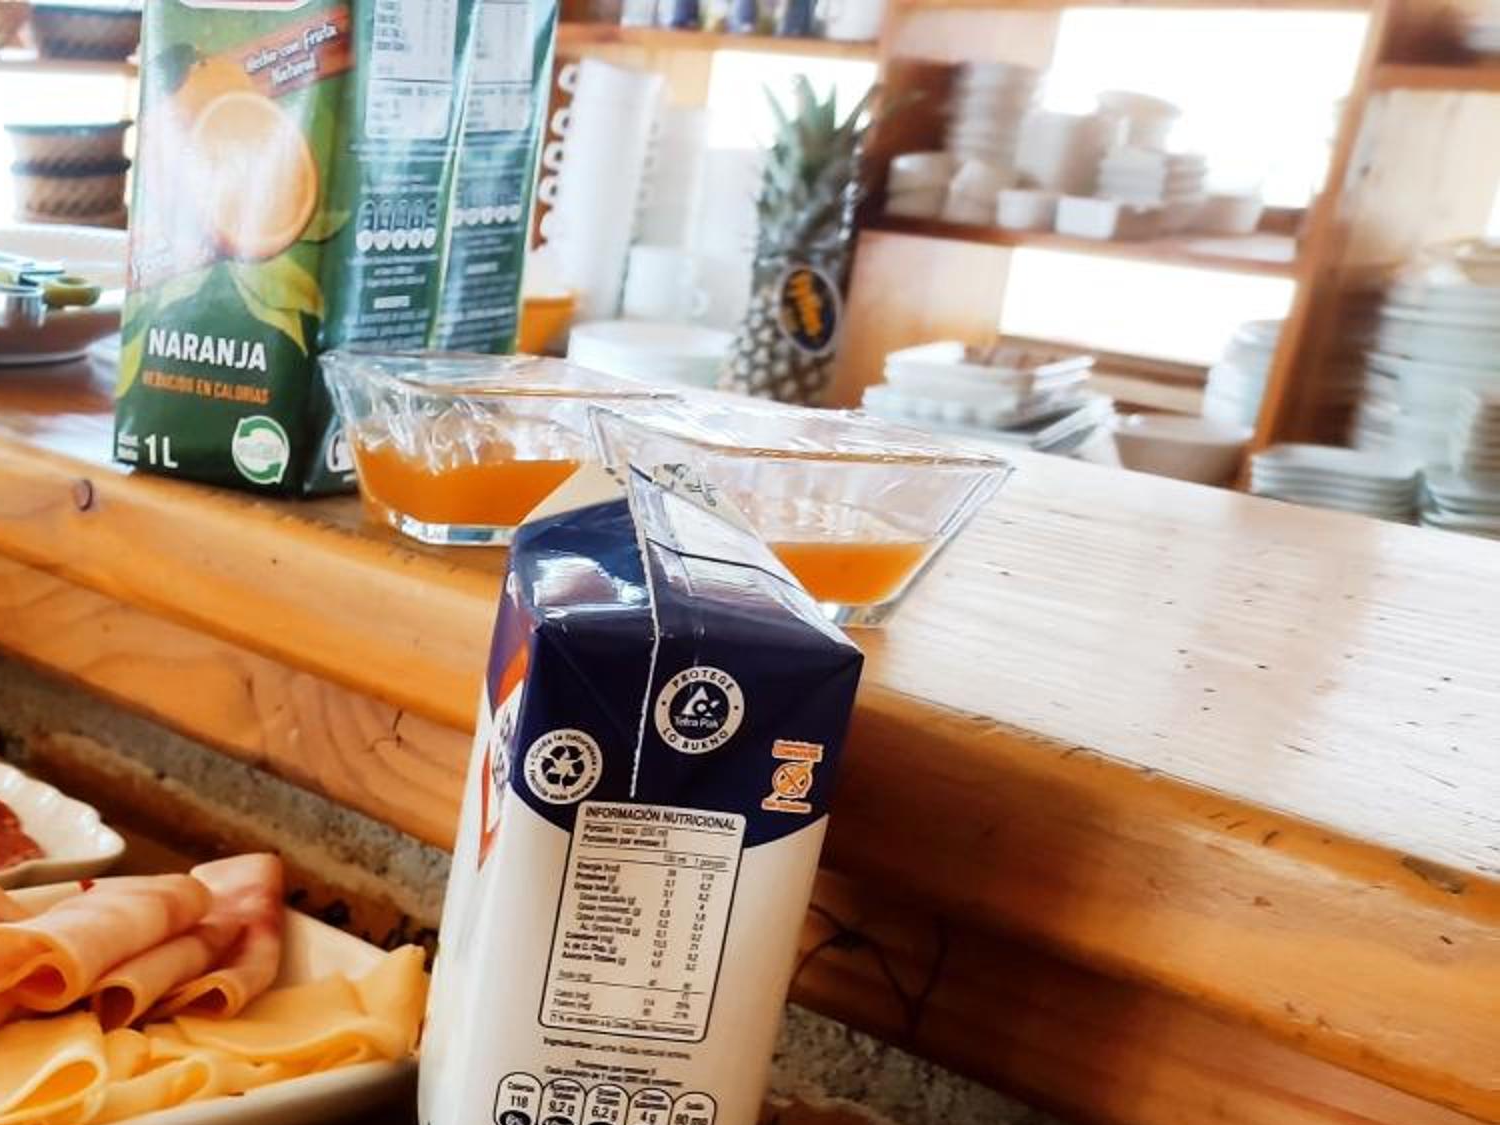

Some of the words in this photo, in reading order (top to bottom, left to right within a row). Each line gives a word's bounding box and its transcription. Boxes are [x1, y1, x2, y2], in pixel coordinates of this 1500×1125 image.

[148, 327, 267, 372] NARANJA
[196, 378, 213, 397] EN
[672, 669, 735, 692] PROTEGE
[674, 715, 697, 728] Tetra
[699, 717, 719, 729] Pak
[662, 727, 678, 743] LO
[681, 729, 729, 751] BUENO
[585, 805, 660, 822] INFORMACIÓN
[662, 811, 737, 831] NUTRICIONAL
